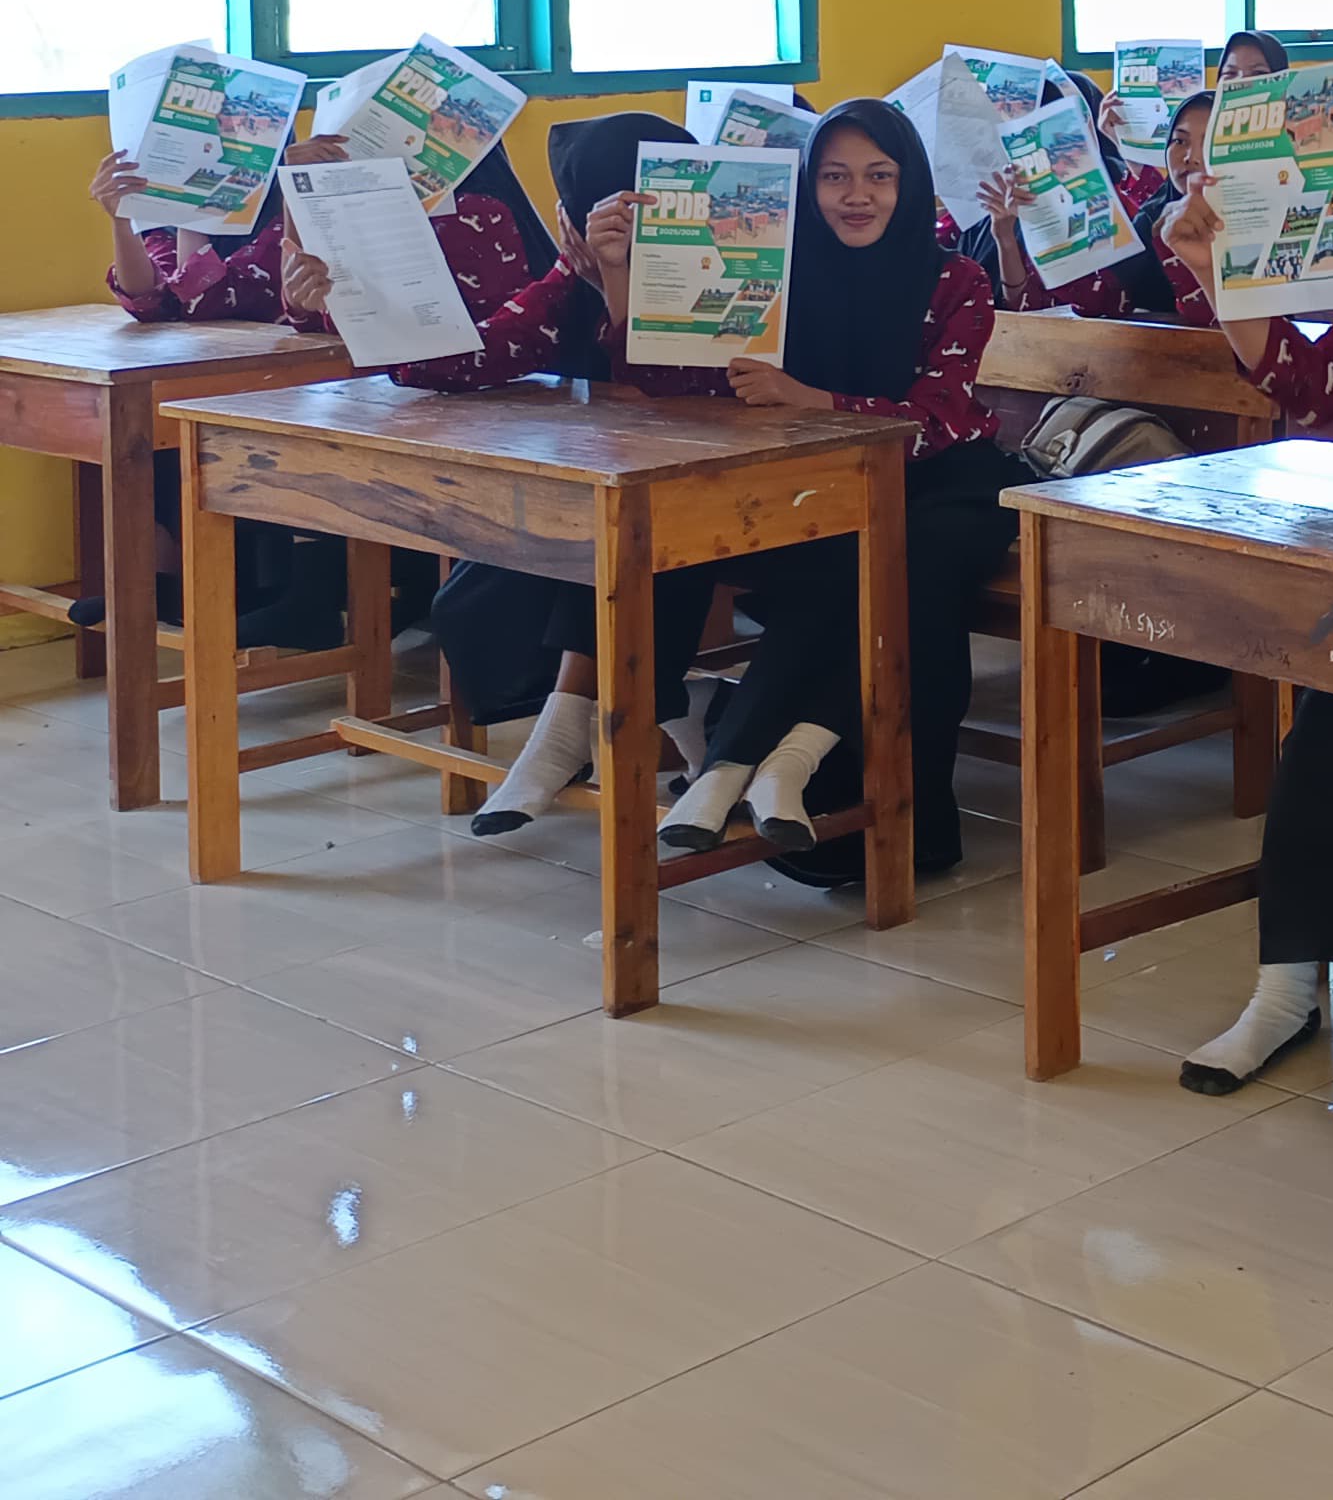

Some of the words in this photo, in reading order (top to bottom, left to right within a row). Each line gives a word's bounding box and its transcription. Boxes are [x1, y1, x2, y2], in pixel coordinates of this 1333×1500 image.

[165, 80, 226, 115] PPDB
[388, 66, 448, 112] PPDB
[1214, 101, 1288, 137] PPDB
